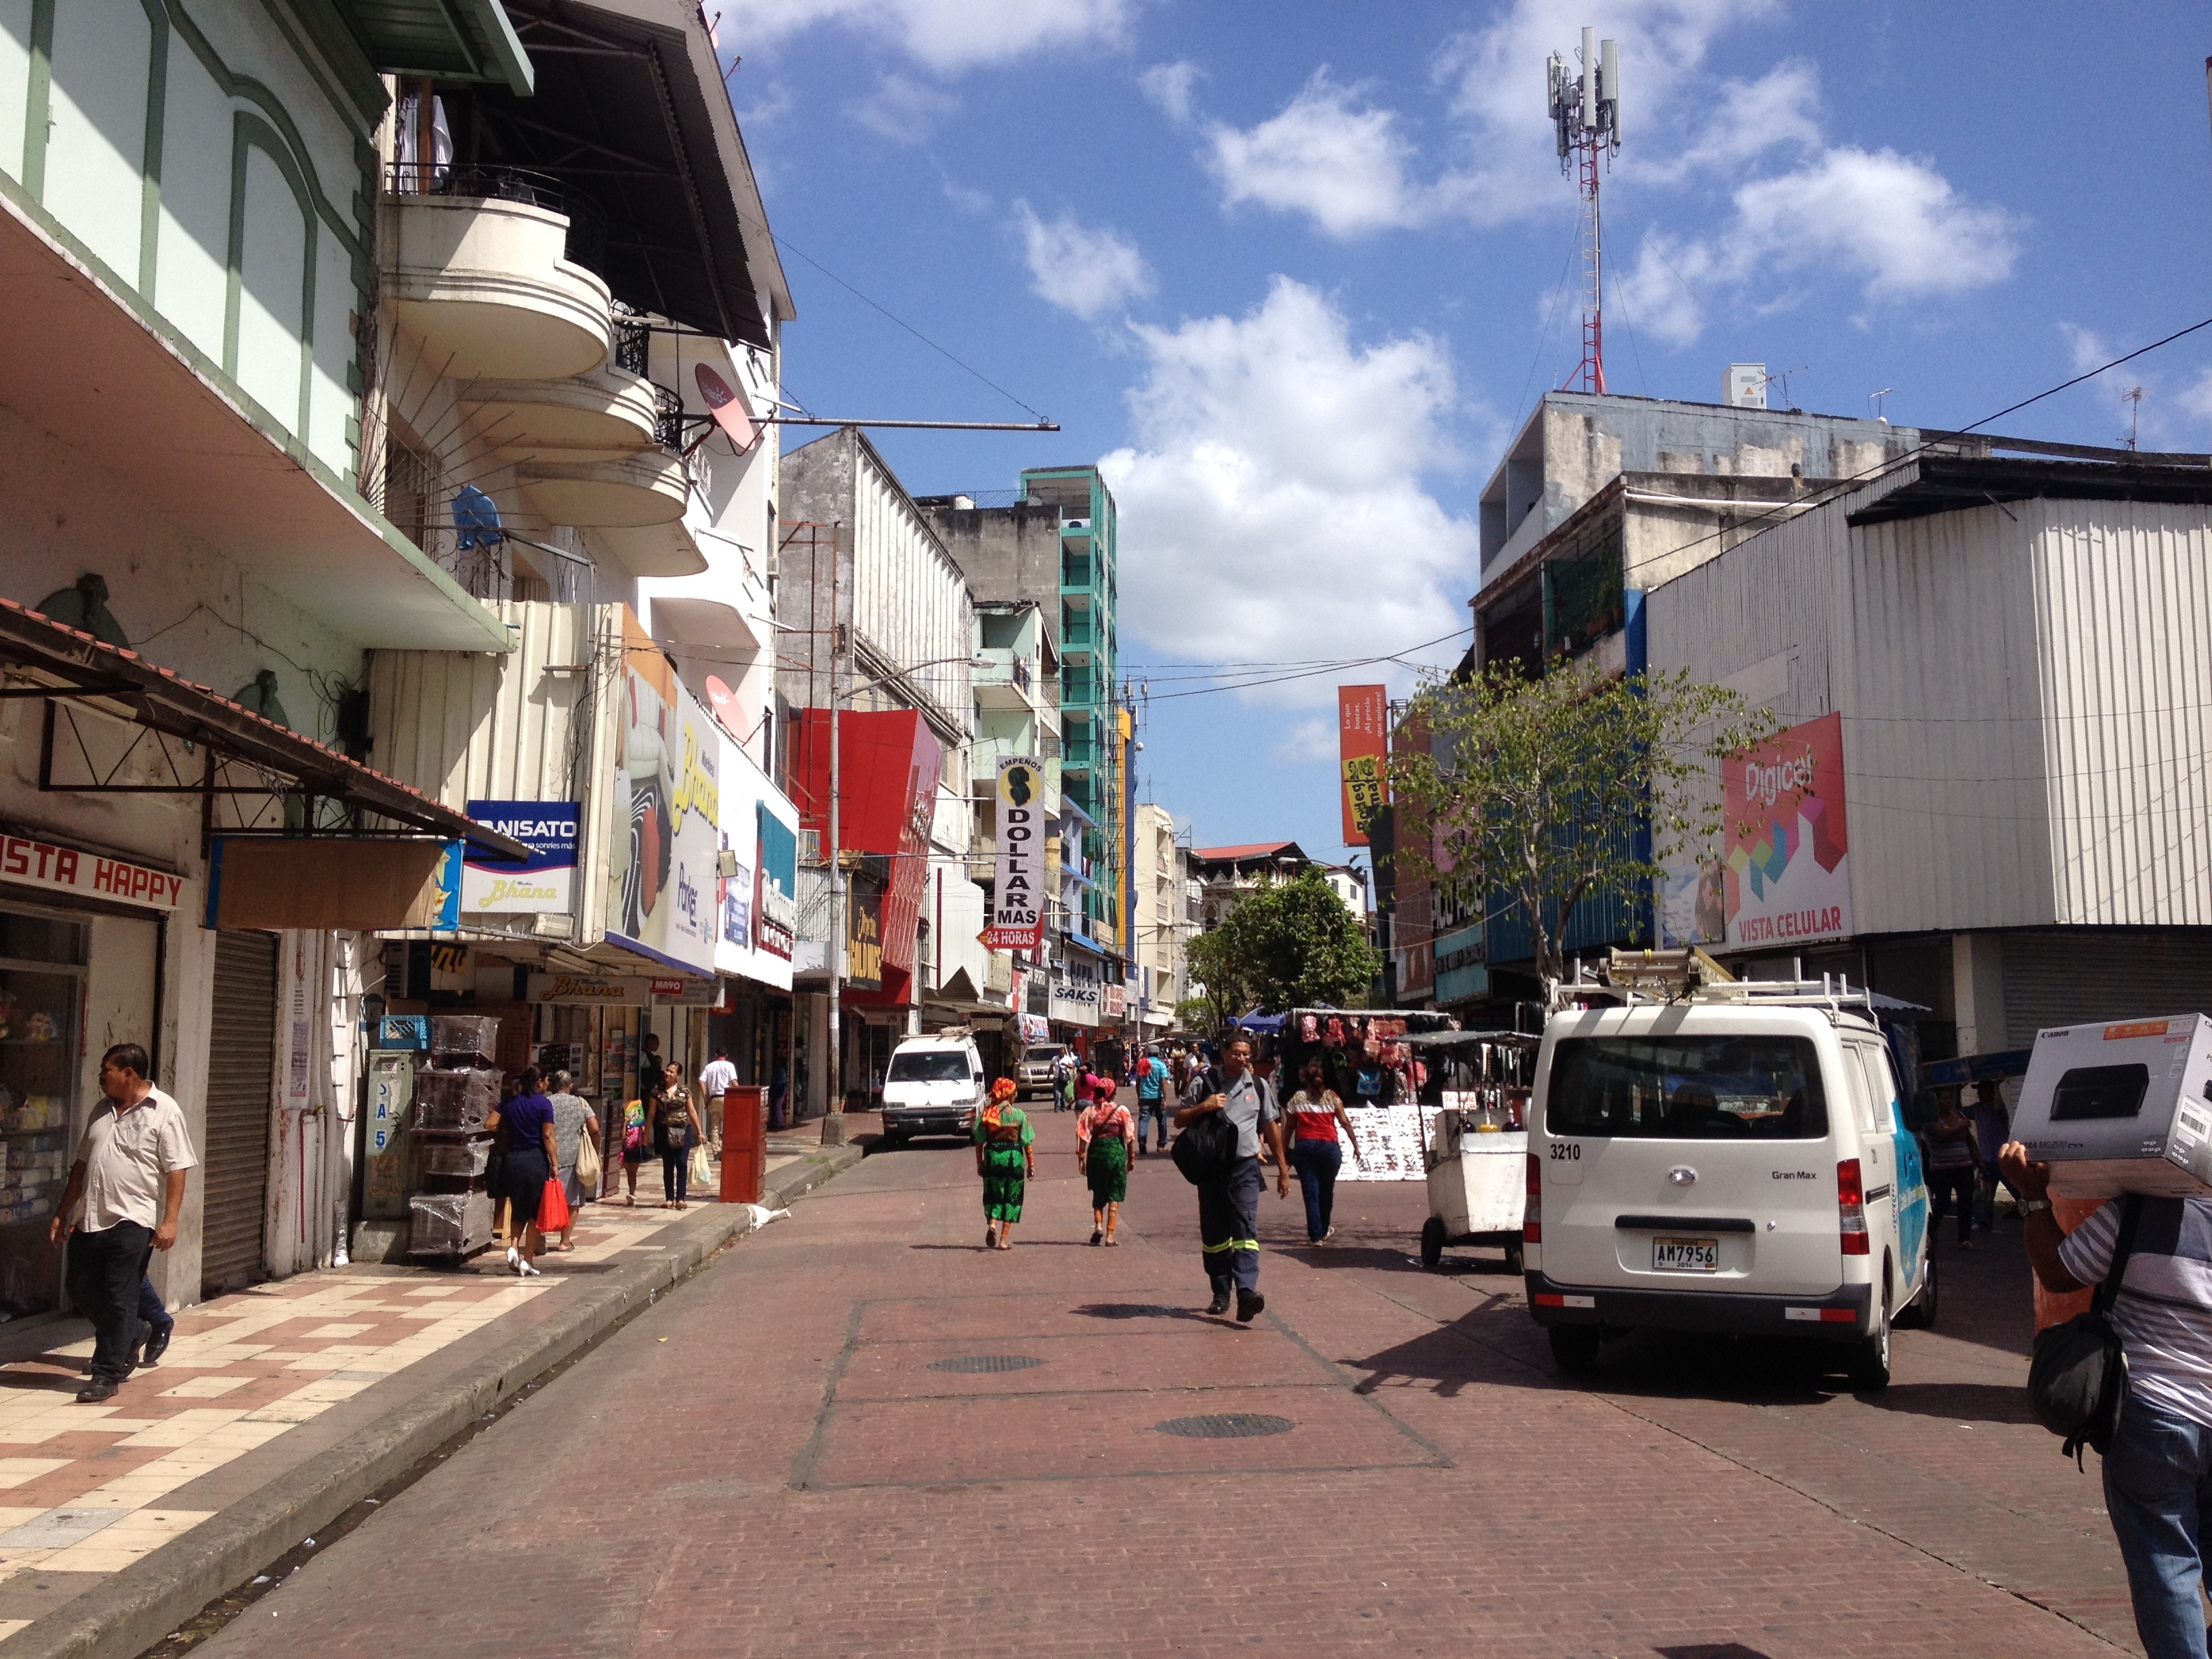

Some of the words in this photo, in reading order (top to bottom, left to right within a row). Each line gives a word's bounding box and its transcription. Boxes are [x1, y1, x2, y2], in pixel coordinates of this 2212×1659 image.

[1345, 719, 1351, 729] Lo
[999, 758, 1042, 772] EMPEÑOS
[1745, 743, 1812, 806] Digicel
[1006, 809, 1031, 907] DOLLAR
[93, 858, 182, 906] HAPPY
[478, 880, 557, 908] Bhana
[998, 909, 1037, 924] MAS
[1739, 916, 1774, 943] VISTA
[1777, 906, 1842, 937] CELULAR
[987, 931, 998, 945] 24
[1001, 931, 1035, 945] HORAS
[539, 975, 625, 1001] Bhana
[655, 980, 680, 990] MAYO
[1054, 987, 1098, 1002] SAKS
[2041, 1029, 2069, 1039] Canon
[1550, 1143, 1581, 1160] 3210
[1771, 1170, 1796, 1180] Gran
[1797, 1170, 1818, 1180] Max
[1658, 1245, 1713, 1263] AM7956
